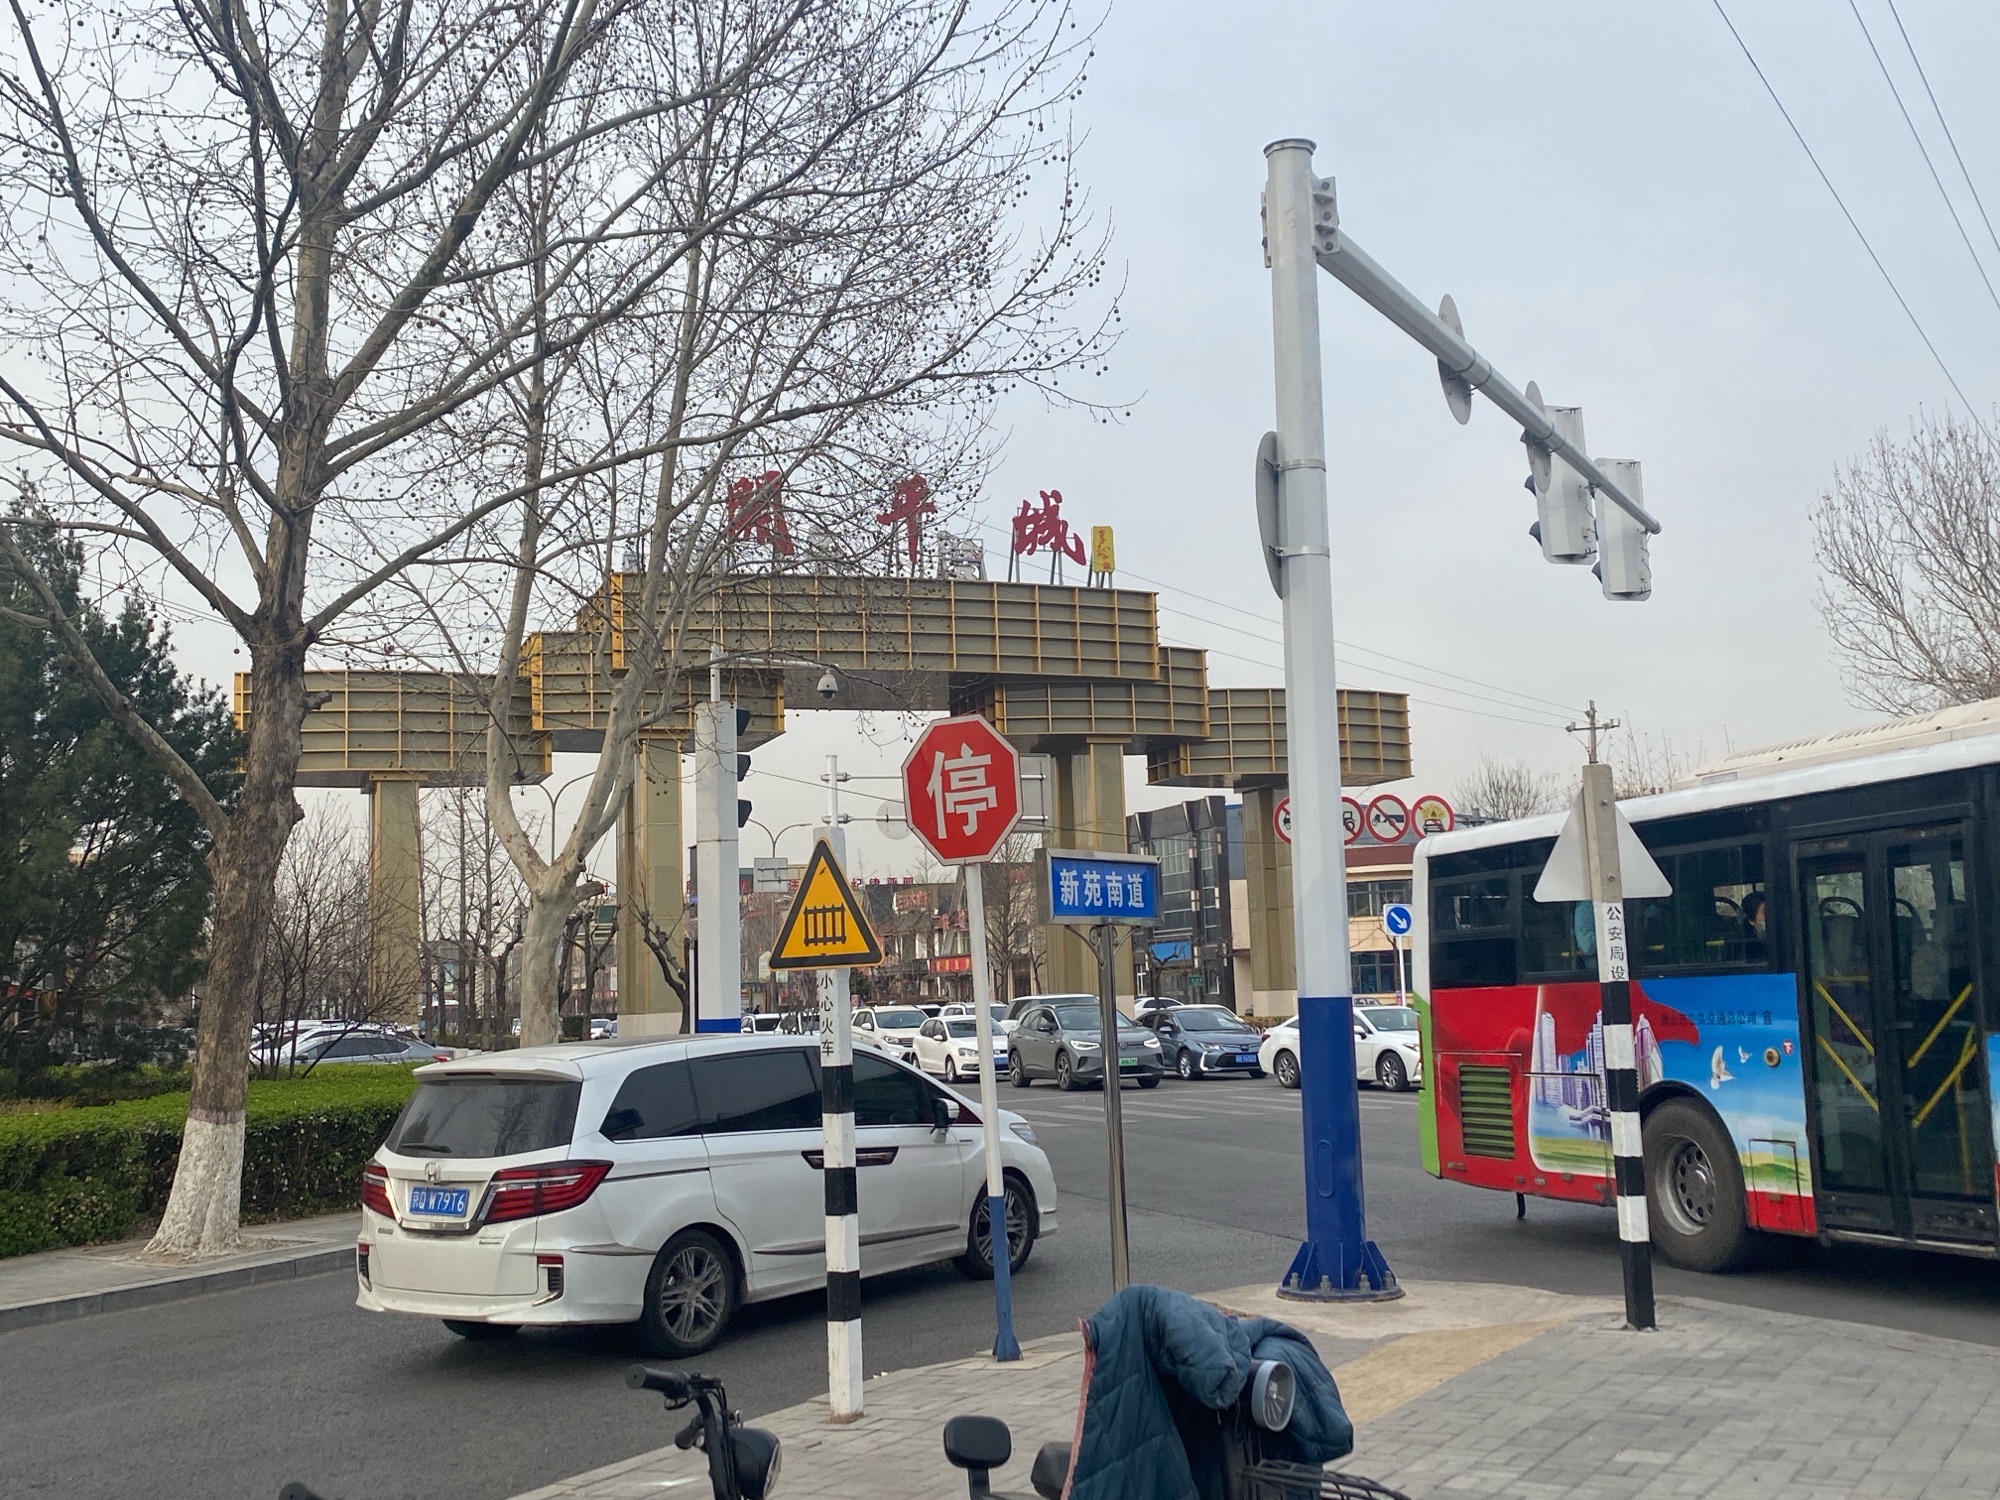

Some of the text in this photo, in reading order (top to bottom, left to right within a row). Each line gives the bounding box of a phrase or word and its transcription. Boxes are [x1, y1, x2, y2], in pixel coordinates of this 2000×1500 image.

[926, 742, 997, 839] 停
[1059, 868, 1144, 908] 新苑南道
[1606, 905, 1626, 980] 公安局设
[820, 972, 835, 1057] 小心火车
